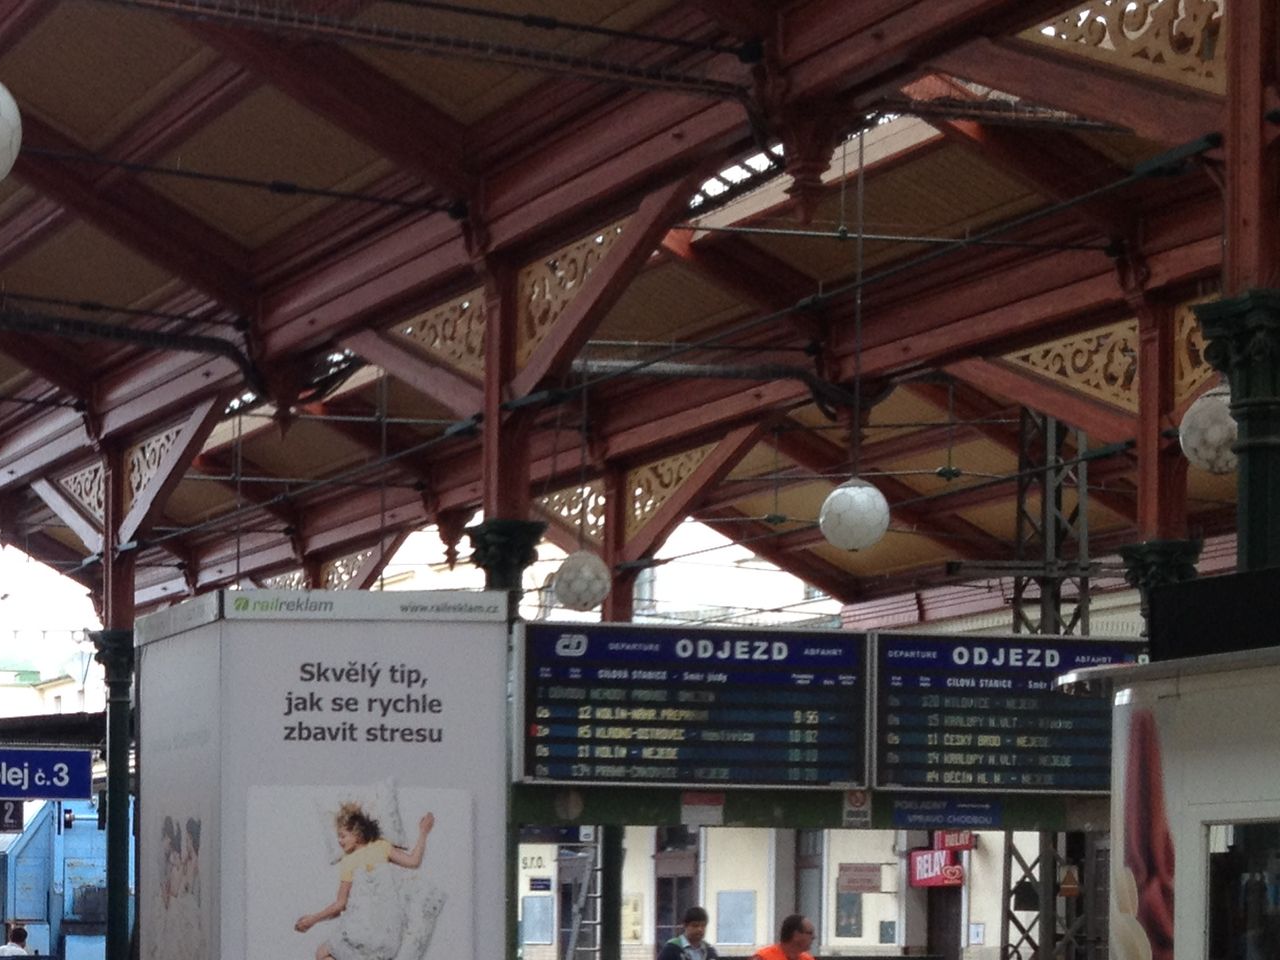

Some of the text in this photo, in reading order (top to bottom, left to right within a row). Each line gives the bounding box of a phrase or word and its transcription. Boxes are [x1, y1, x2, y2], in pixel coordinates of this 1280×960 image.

[252, 598, 334, 613] railreklam
[675, 638, 789, 661] ODJEZD
[952, 646, 1060, 668] ODJEZD
[300, 661, 428, 689] Skvělý tip,
[283, 691, 442, 718] jak se rychle
[284, 721, 443, 743] zbavit stresu
[944, 832, 973, 847] RELAY
[916, 850, 947, 882] RELAY
